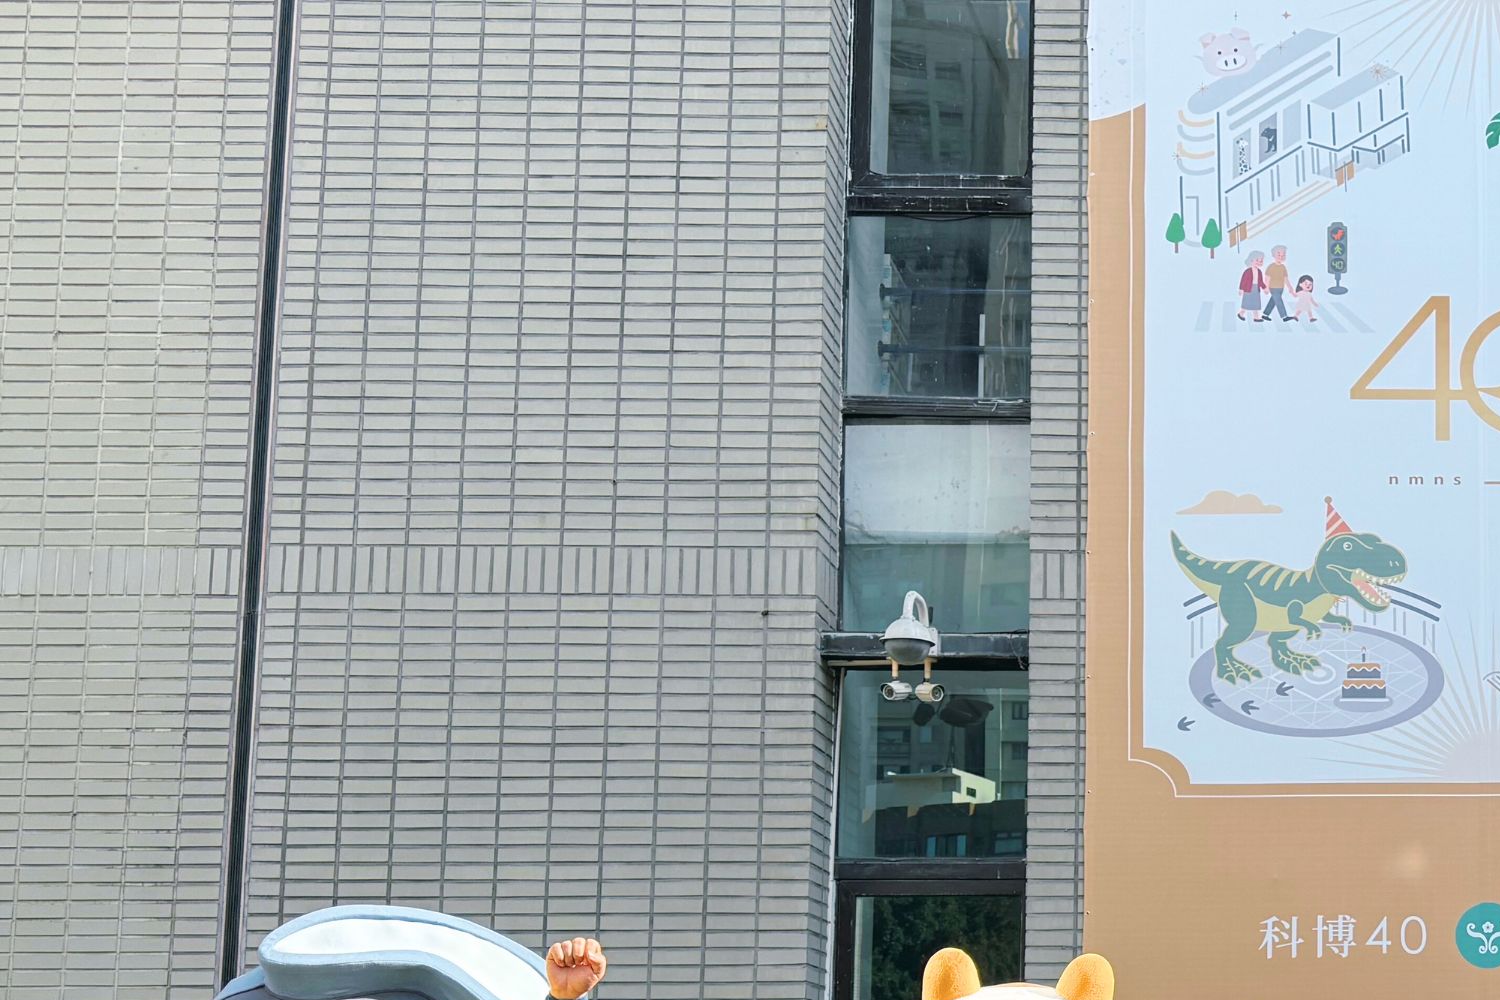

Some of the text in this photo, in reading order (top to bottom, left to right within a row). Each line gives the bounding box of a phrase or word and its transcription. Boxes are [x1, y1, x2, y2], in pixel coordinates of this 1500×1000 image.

[1331, 259, 1343, 270] 40
[1388, 475, 1462, 486] nmns
[1258, 914, 1428, 960] 科博40
